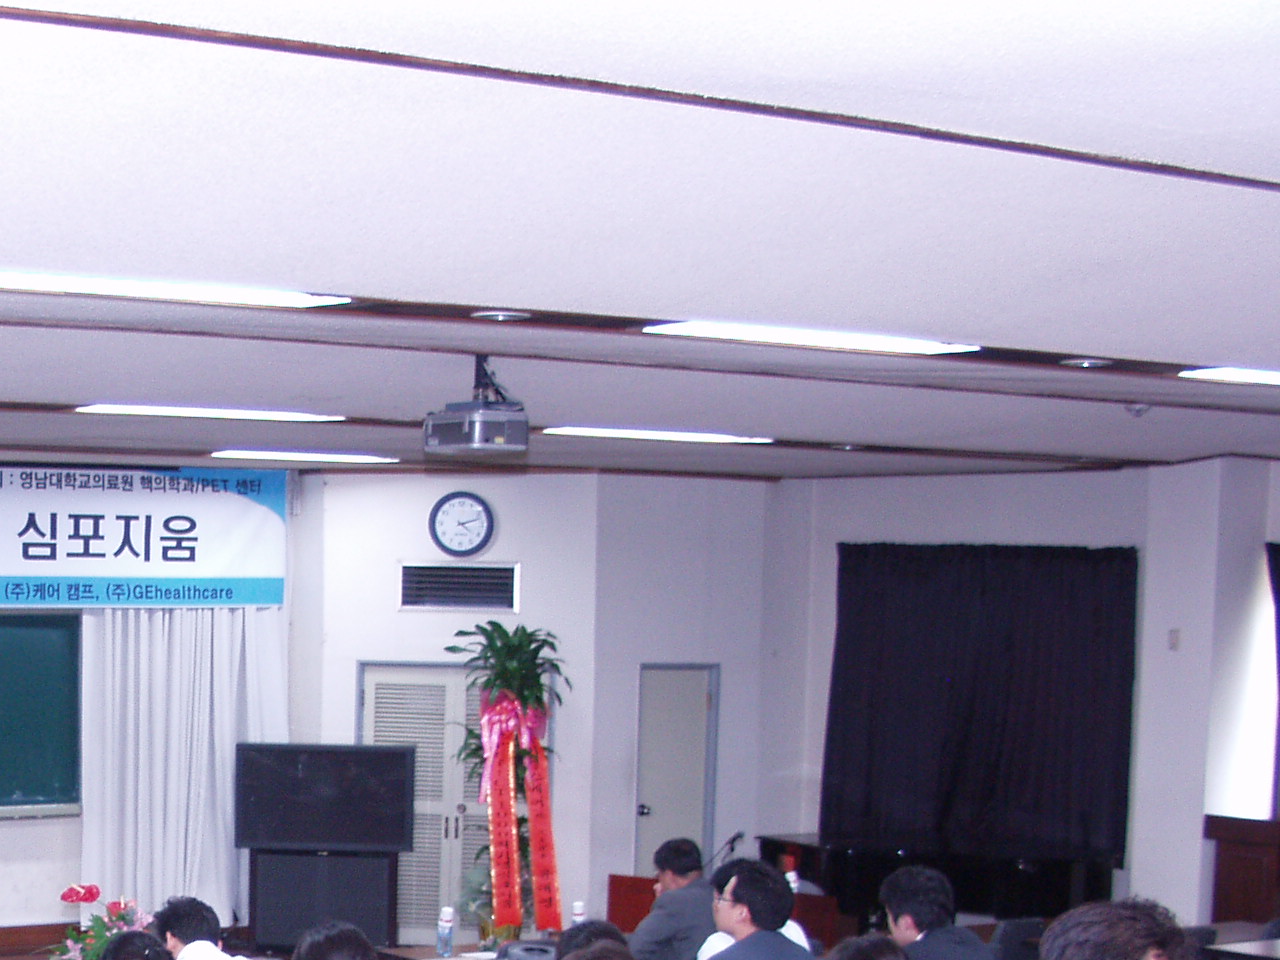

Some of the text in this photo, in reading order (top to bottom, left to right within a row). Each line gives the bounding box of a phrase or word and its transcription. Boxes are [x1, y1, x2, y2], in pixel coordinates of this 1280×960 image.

[19, 472, 134, 491] 영남대학교의료원
[140, 474, 230, 494] 핵의학과/PET
[235, 478, 262, 496] 센터
[17, 511, 199, 562] 심포지움
[5, 583, 61, 601] (주)케어
[106, 583, 234, 602] (주)GEhealthcare
